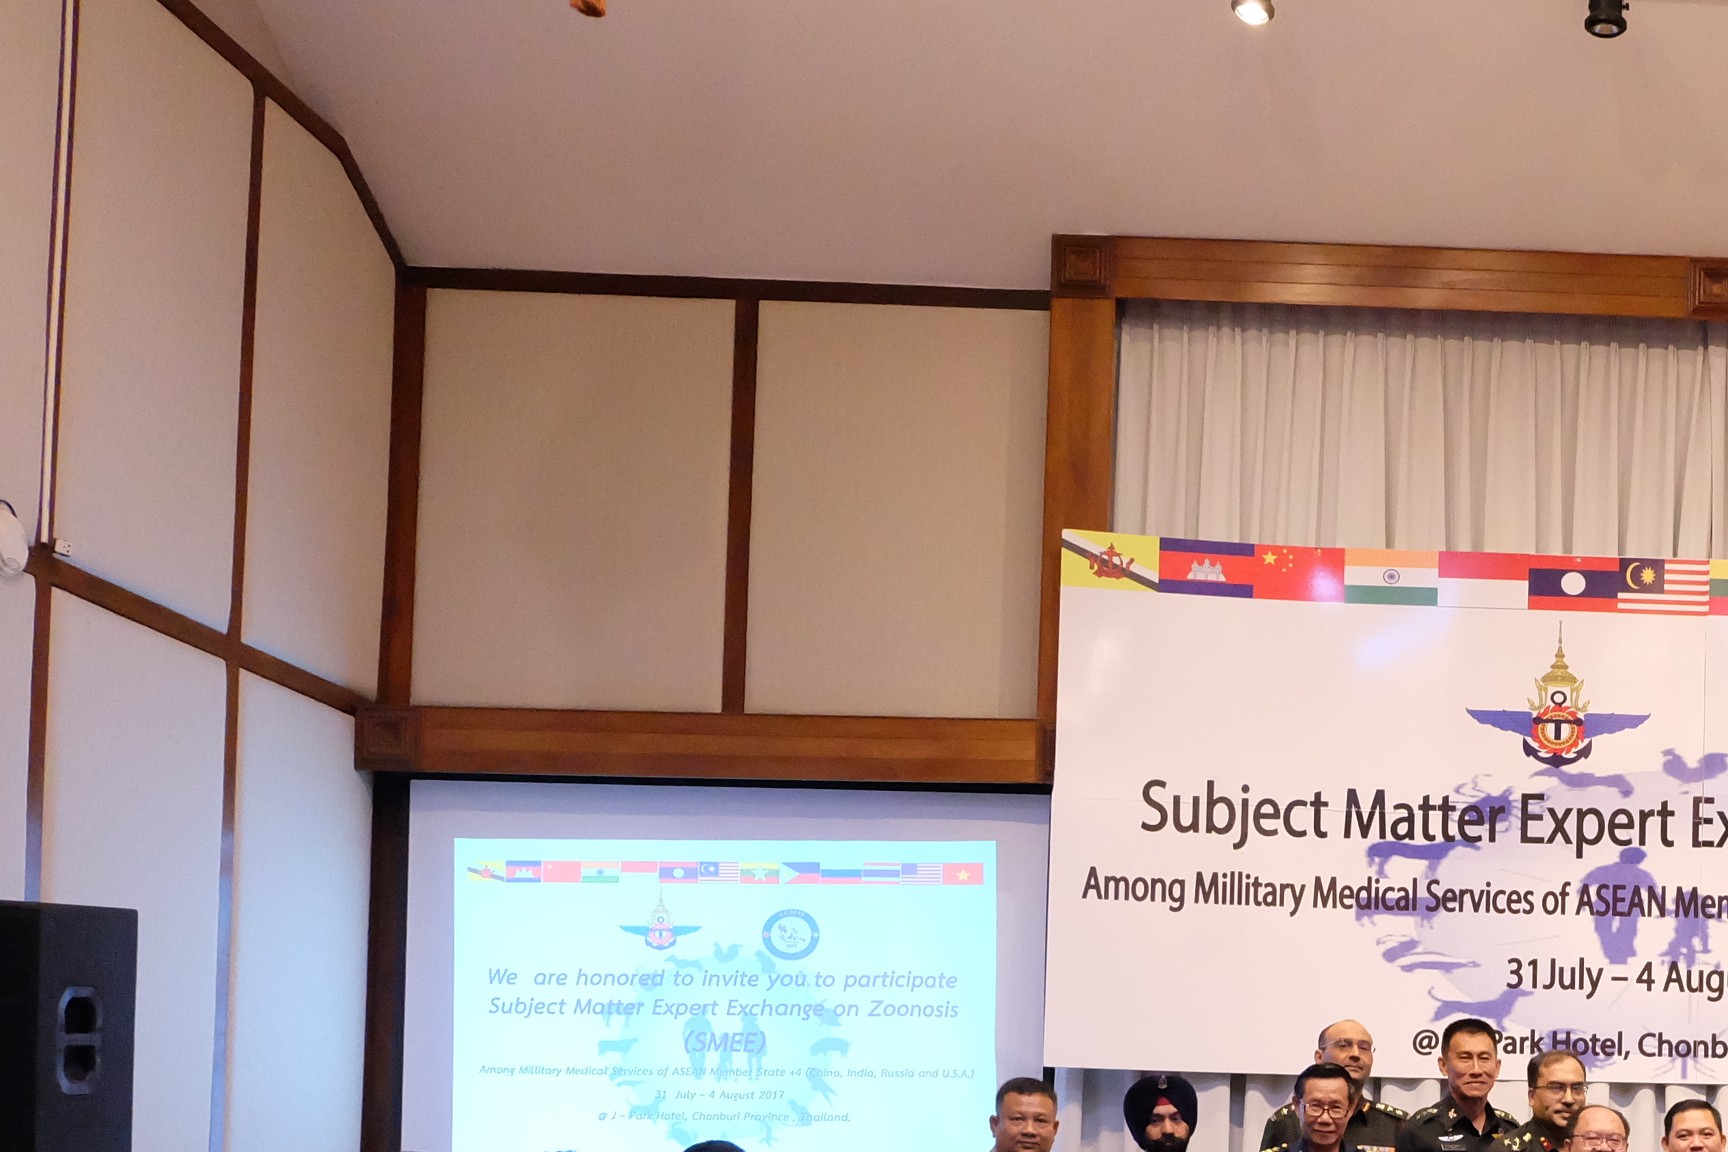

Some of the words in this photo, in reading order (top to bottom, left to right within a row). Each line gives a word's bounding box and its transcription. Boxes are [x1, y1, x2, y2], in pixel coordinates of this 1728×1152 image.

[1141, 779, 1329, 850] Subject
[1343, 788, 1506, 844] Matter
[1520, 793, 1675, 859] Expert
[1081, 866, 1186, 913] Among
[1194, 871, 1306, 917] Millitary
[1312, 876, 1418, 912] Medical
[1426, 879, 1535, 916] Services
[1541, 881, 1571, 916] of
[1575, 884, 1666, 918] ASEAN
[488, 968, 518, 986] We
[534, 972, 568, 986] are
[576, 968, 665, 987] honored
[673, 970, 694, 987] to
[702, 969, 759, 988] invite
[766, 973, 806, 991] you
[814, 972, 835, 988] to
[843, 971, 958, 992] participate
[1505, 958, 1603, 999] 31July
[1636, 961, 1656, 992] 4
[488, 997, 567, 1018] Subject
[573, 998, 645, 1016] Matter
[652, 999, 719, 1019] Expert
[726, 999, 825, 1021] Exchange
[833, 1003, 860, 1018] on
[867, 1000, 960, 1018] Zoonosis
[683, 1029, 767, 1054] (SMEE)
[1412, 1029, 1439, 1056] @
[1552, 1030, 1631, 1060] Hotel,
[479, 1065, 515, 1077] Among
[565, 1066, 608, 1077] Medical
[611, 1066, 653, 1077] Services
[657, 1066, 669, 1077] of
[671, 1067, 706, 1077] ASEAN
[709, 1067, 752, 1078] Member
[756, 1068, 786, 1078] State
[789, 1069, 802, 1078] +4
[805, 1067, 843, 1080] (China,
[847, 1068, 877, 1080] India,
[880, 1068, 916, 1079] Russia
[918, 1068, 940, 1079] and
[942, 1069, 975, 1080] U.S.A.)
[655, 1090, 667, 1100] 31
[674, 1090, 697, 1101] July
[708, 1090, 716, 1100] 4
[719, 1091, 756, 1102] August
[760, 1091, 785, 1100] 2017
[629, 1111, 653, 1121] Park
[656, 1111, 688, 1122] Hotel,
[691, 1111, 740, 1122] Chonburi
[743, 1112, 790, 1122] Province
[800, 1112, 851, 1122] Thailand.
